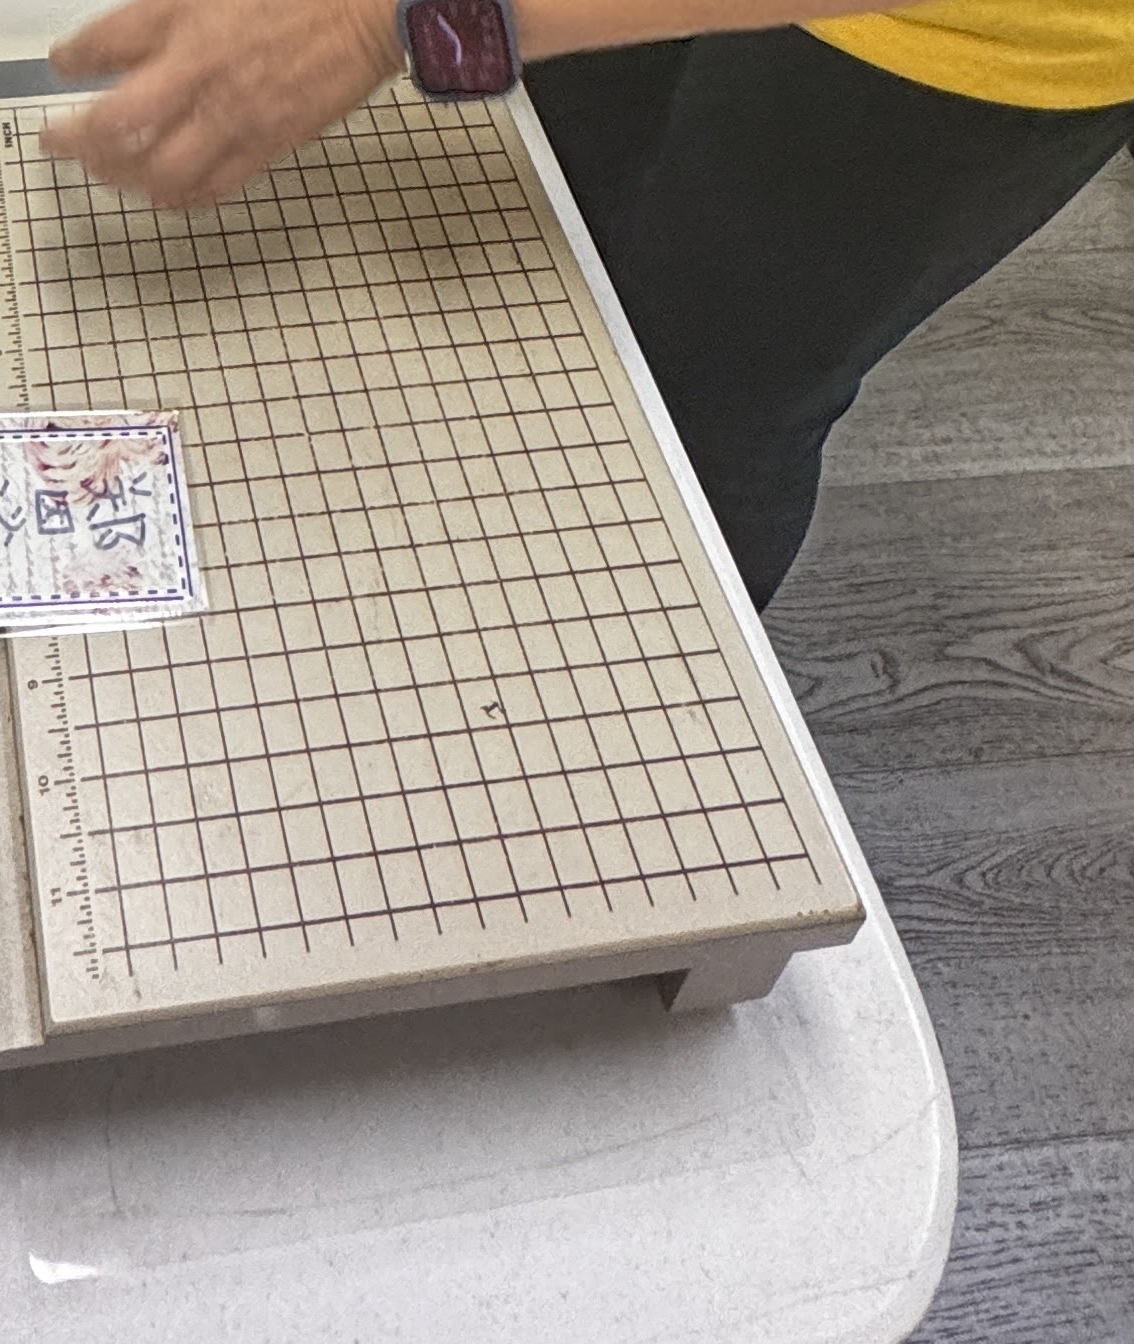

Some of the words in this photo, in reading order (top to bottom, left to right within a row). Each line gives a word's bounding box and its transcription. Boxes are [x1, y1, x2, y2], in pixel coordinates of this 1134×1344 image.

[2, 122, 13, 149] INCH
[28, 680, 38, 691] 9
[37, 774, 50, 797] 10
[50, 887, 63, 907] 11
